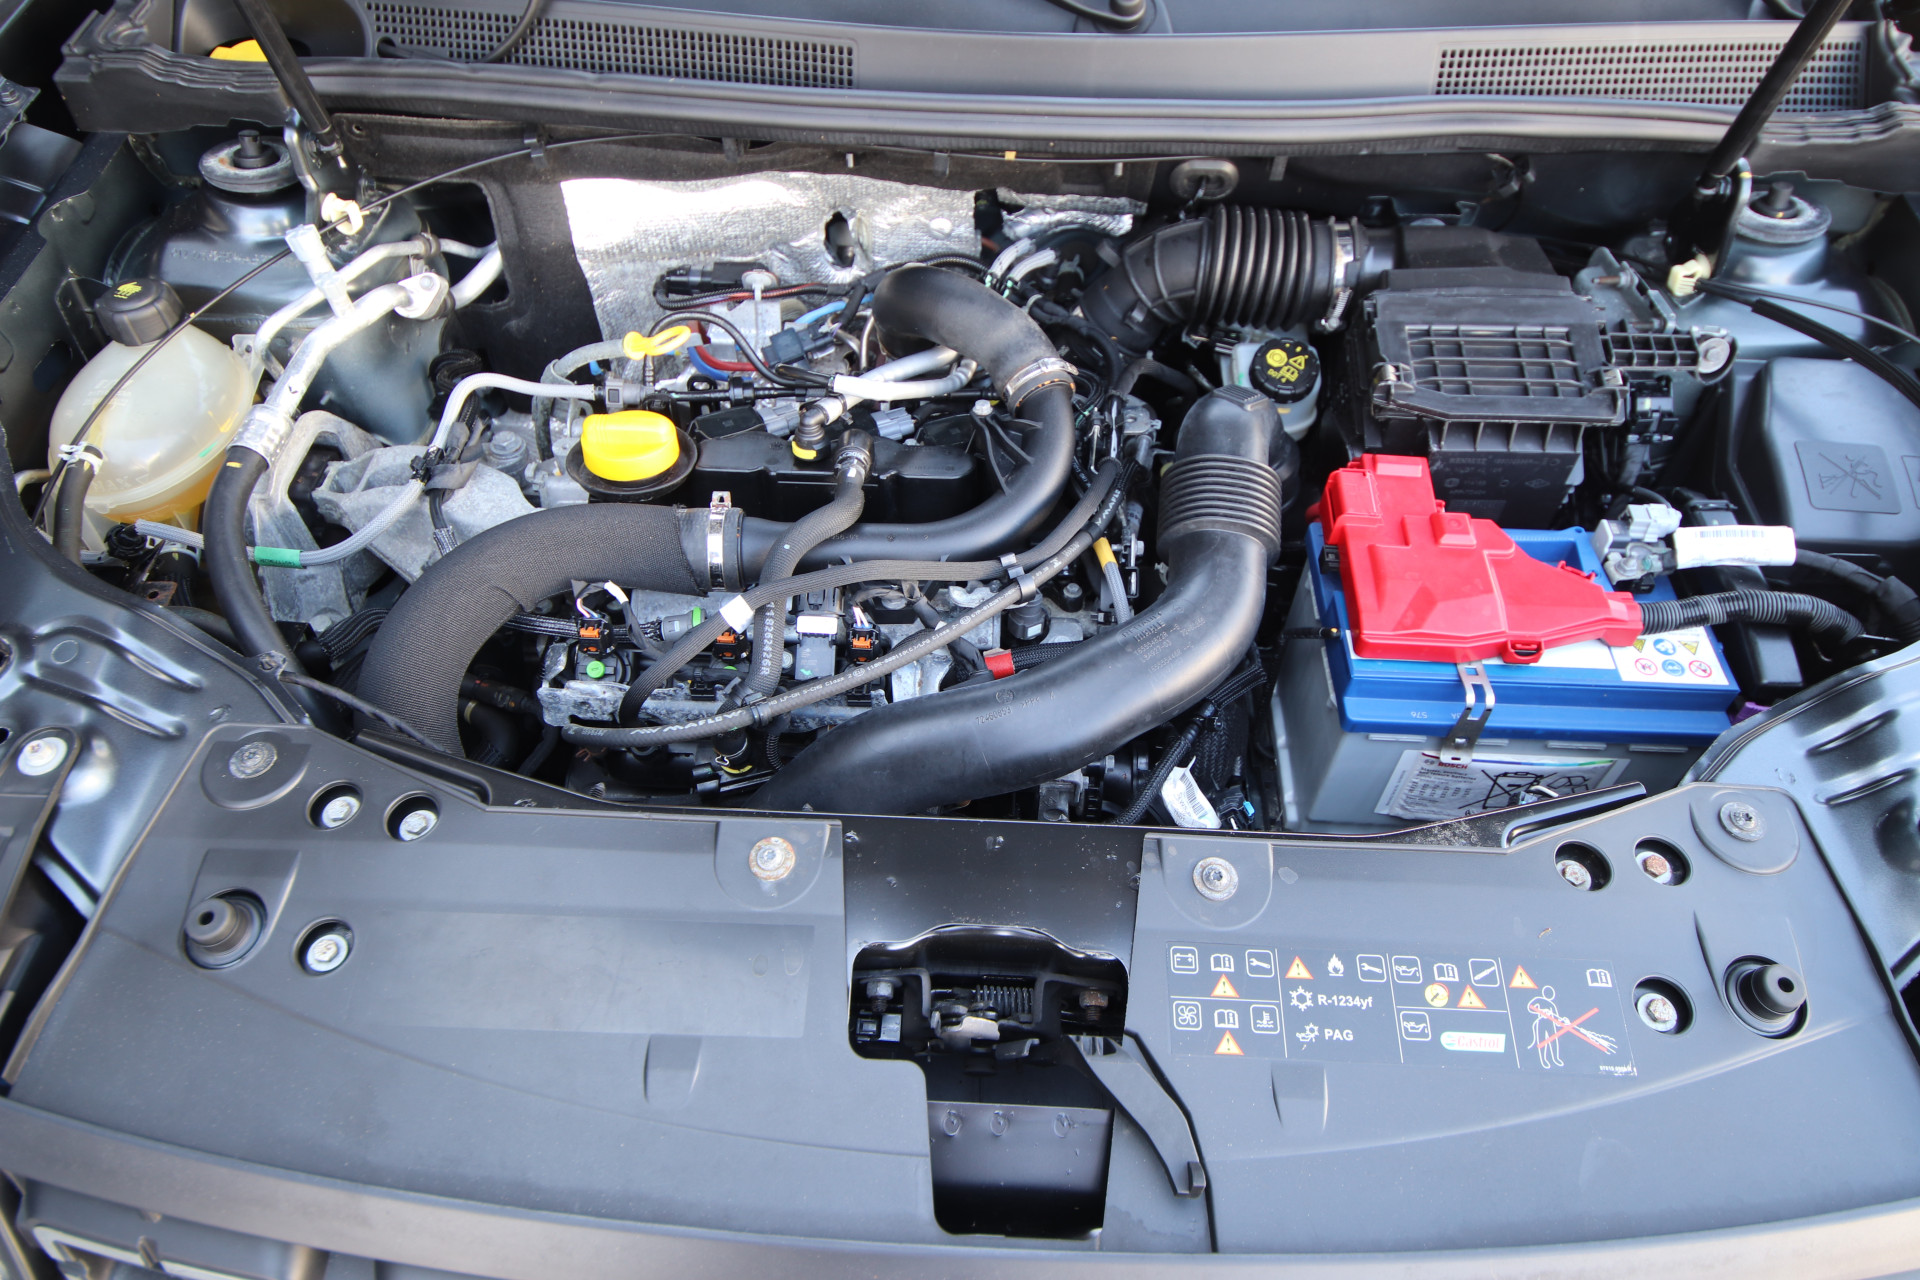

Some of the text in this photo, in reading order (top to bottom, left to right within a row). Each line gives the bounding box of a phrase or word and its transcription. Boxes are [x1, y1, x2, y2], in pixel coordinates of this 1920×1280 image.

[662, 709, 745, 732] MAFLOW
[1317, 993, 1373, 1011] R-1234yf
[1324, 1028, 1354, 1042] PAG
[1457, 1035, 1500, 1048] Castrol
